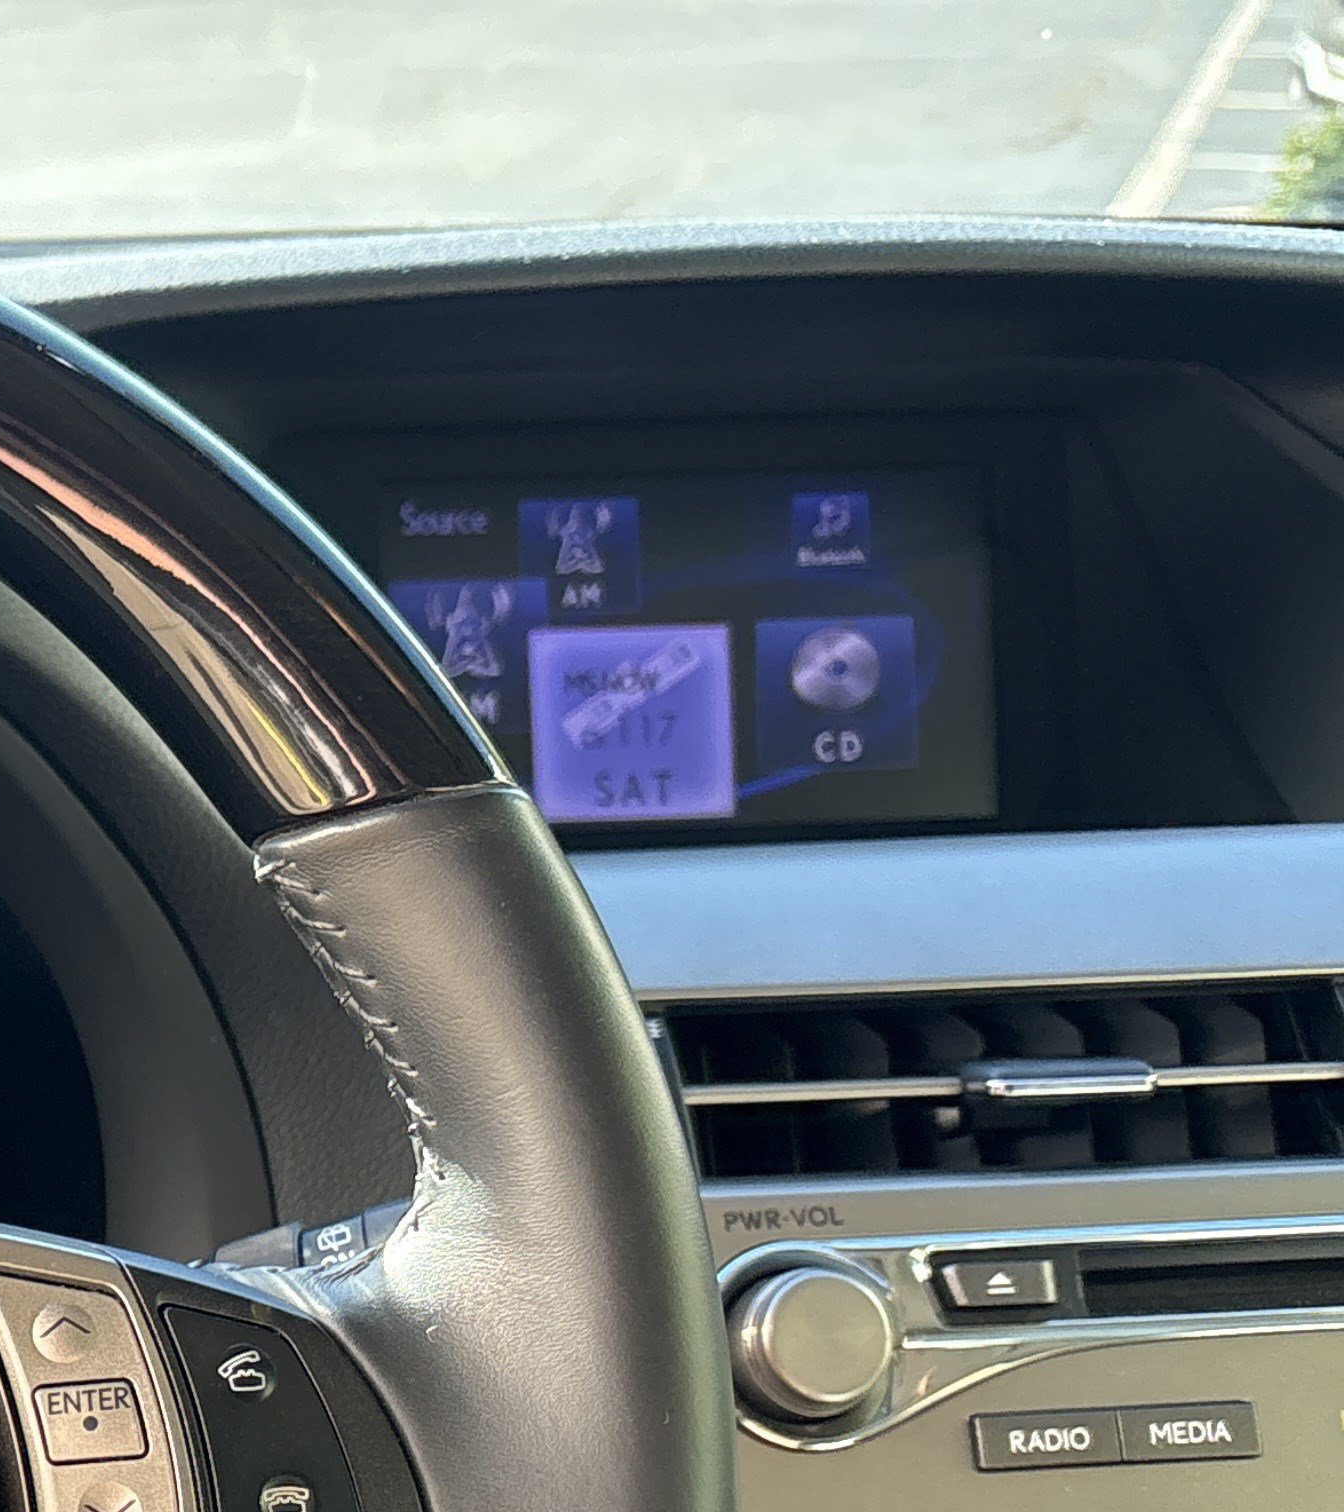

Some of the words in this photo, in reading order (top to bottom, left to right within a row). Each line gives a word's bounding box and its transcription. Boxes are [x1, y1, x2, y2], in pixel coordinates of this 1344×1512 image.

[398, 500, 489, 538] Source
[561, 582, 603, 608] AM
[814, 731, 862, 762] CD
[593, 769, 674, 807] SAT
[46, 1386, 131, 1416] ENTER
[1009, 1427, 1090, 1453] RADIO
[1149, 1421, 1232, 1445] MEDIA
